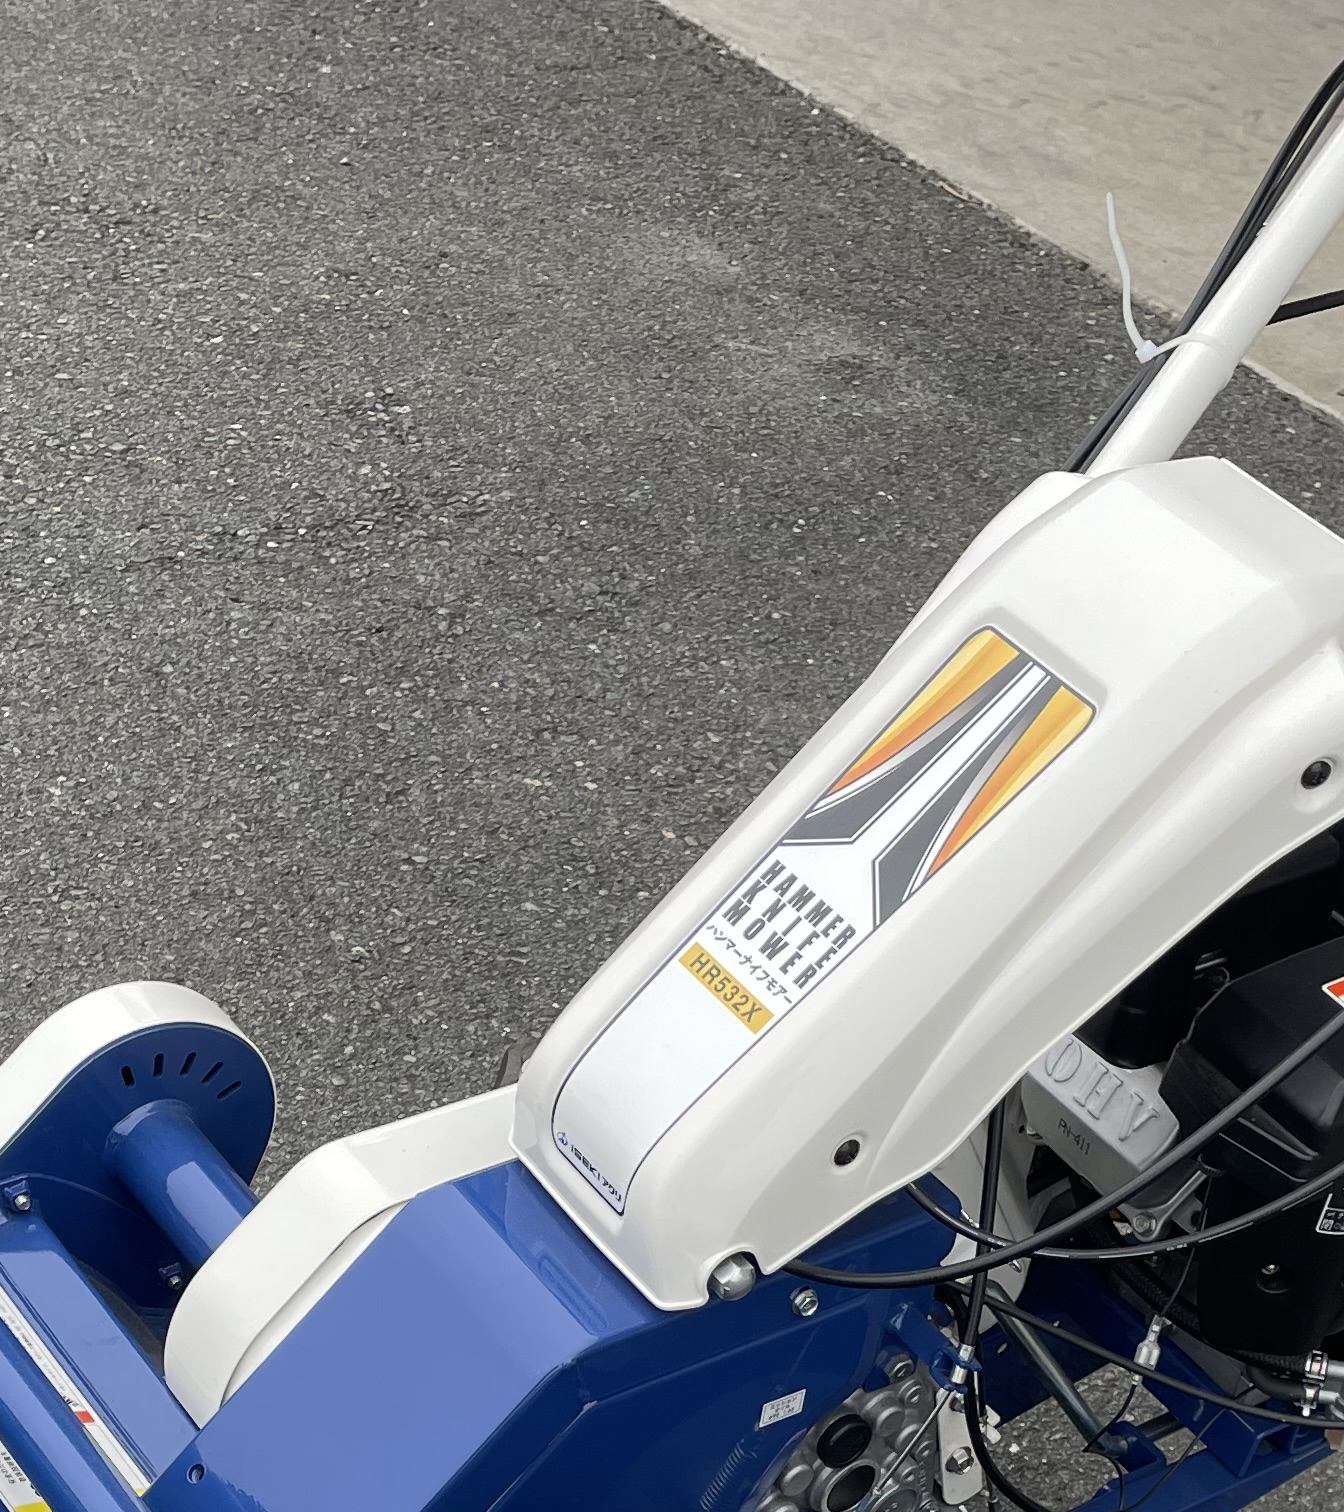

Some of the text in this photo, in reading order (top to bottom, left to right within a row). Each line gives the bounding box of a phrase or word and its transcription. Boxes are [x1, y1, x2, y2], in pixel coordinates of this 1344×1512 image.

[721, 897, 818, 989] MOWER
[740, 878, 839, 970] KNIFE
[759, 859, 857, 950] HAMMER
[688, 952, 763, 1024] HR532X
[706, 925, 793, 1004] ハンマーナイフモアー
[1044, 1037, 1160, 1142] OHV
